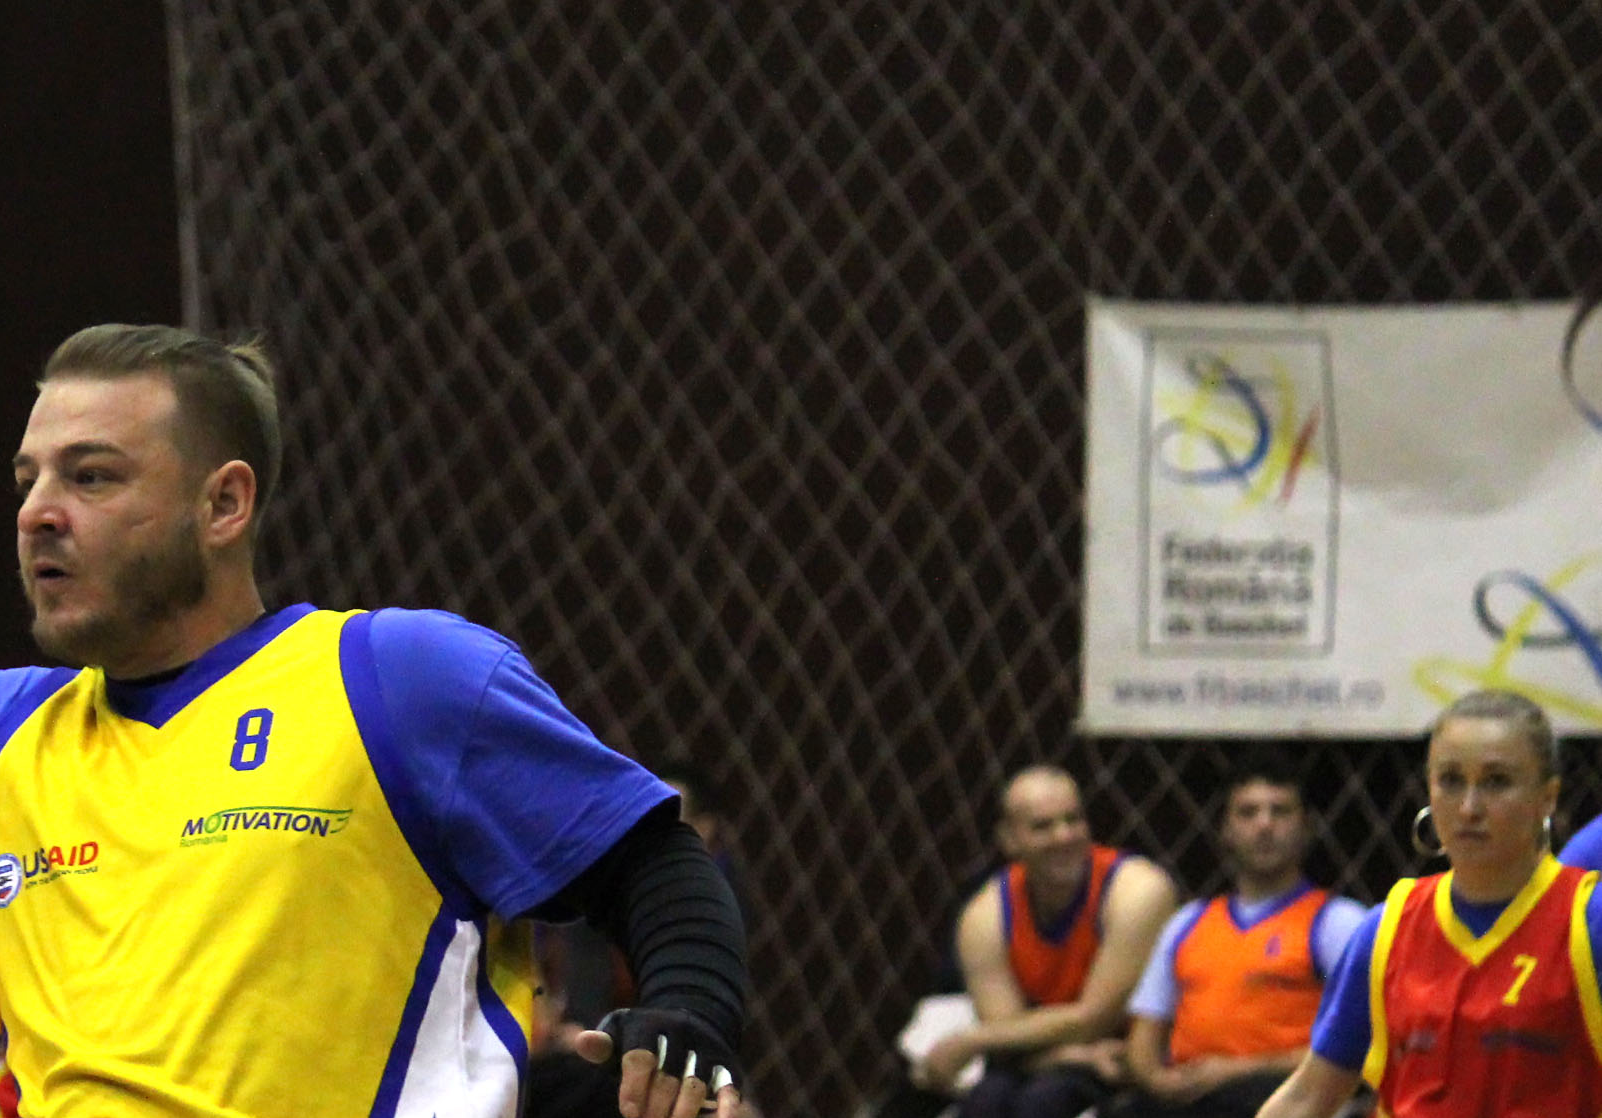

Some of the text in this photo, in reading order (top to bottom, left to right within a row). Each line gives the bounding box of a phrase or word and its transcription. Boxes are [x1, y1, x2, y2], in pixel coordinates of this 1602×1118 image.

[229, 707, 274, 771] 8
[181, 811, 330, 837] MOTIVATION
[23, 841, 99, 879] USAID
[1502, 954, 1538, 1005] 7
